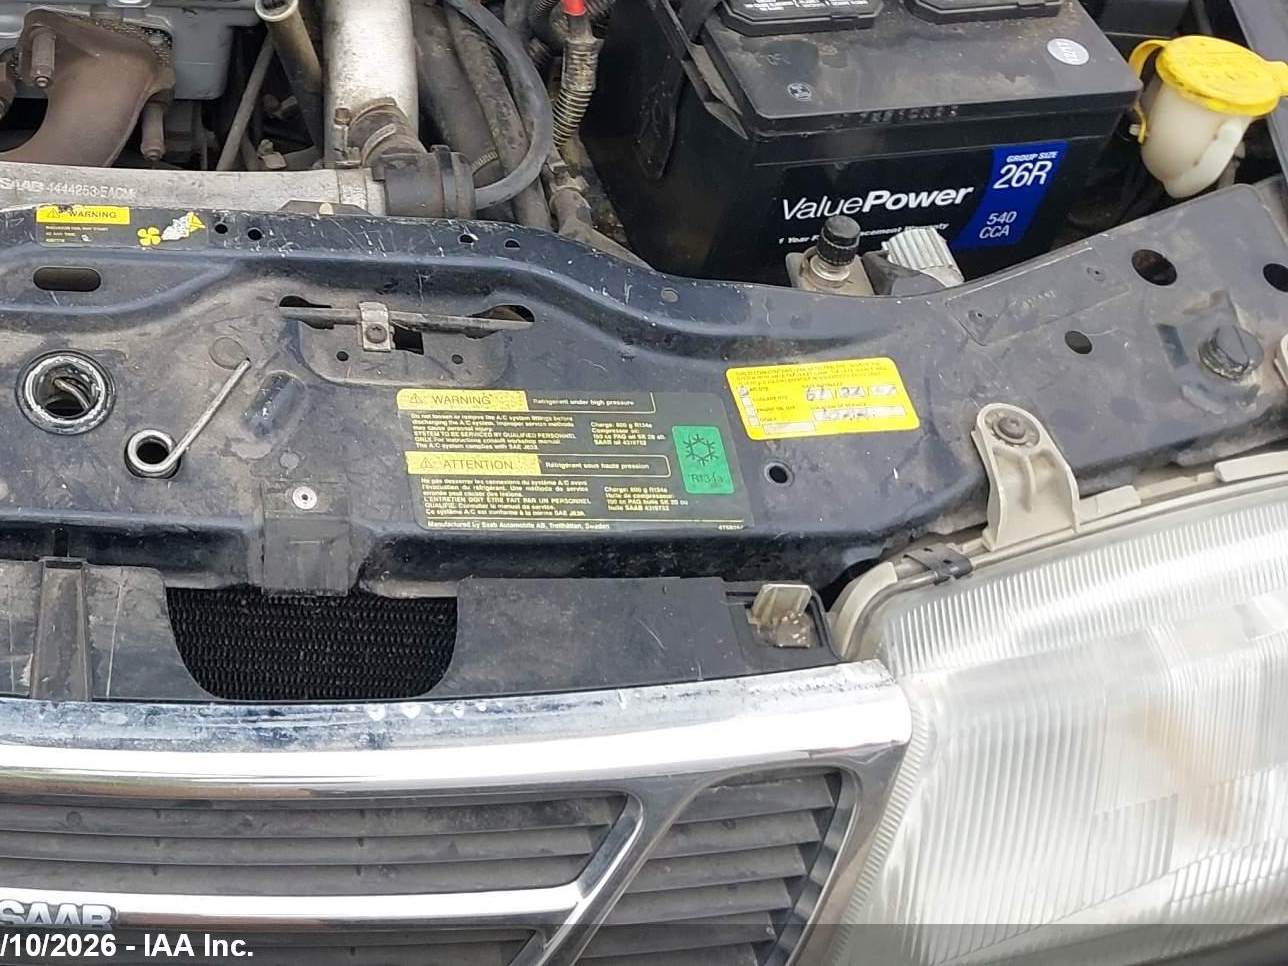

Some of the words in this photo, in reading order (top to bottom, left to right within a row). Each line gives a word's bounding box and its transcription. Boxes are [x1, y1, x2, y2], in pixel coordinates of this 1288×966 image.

[1006, 153, 1036, 163] GROUP
[1038, 151, 1059, 160] SIZE
[993, 160, 1054, 189] 26R
[0, 177, 45, 193] SAAB
[782, 186, 975, 221] ValuePower
[69, 208, 117, 218] WARNING
[986, 210, 1017, 225] 540
[978, 225, 1010, 239] CCA
[432, 395, 491, 404] WARNING
[443, 460, 513, 470] ATTENTION
